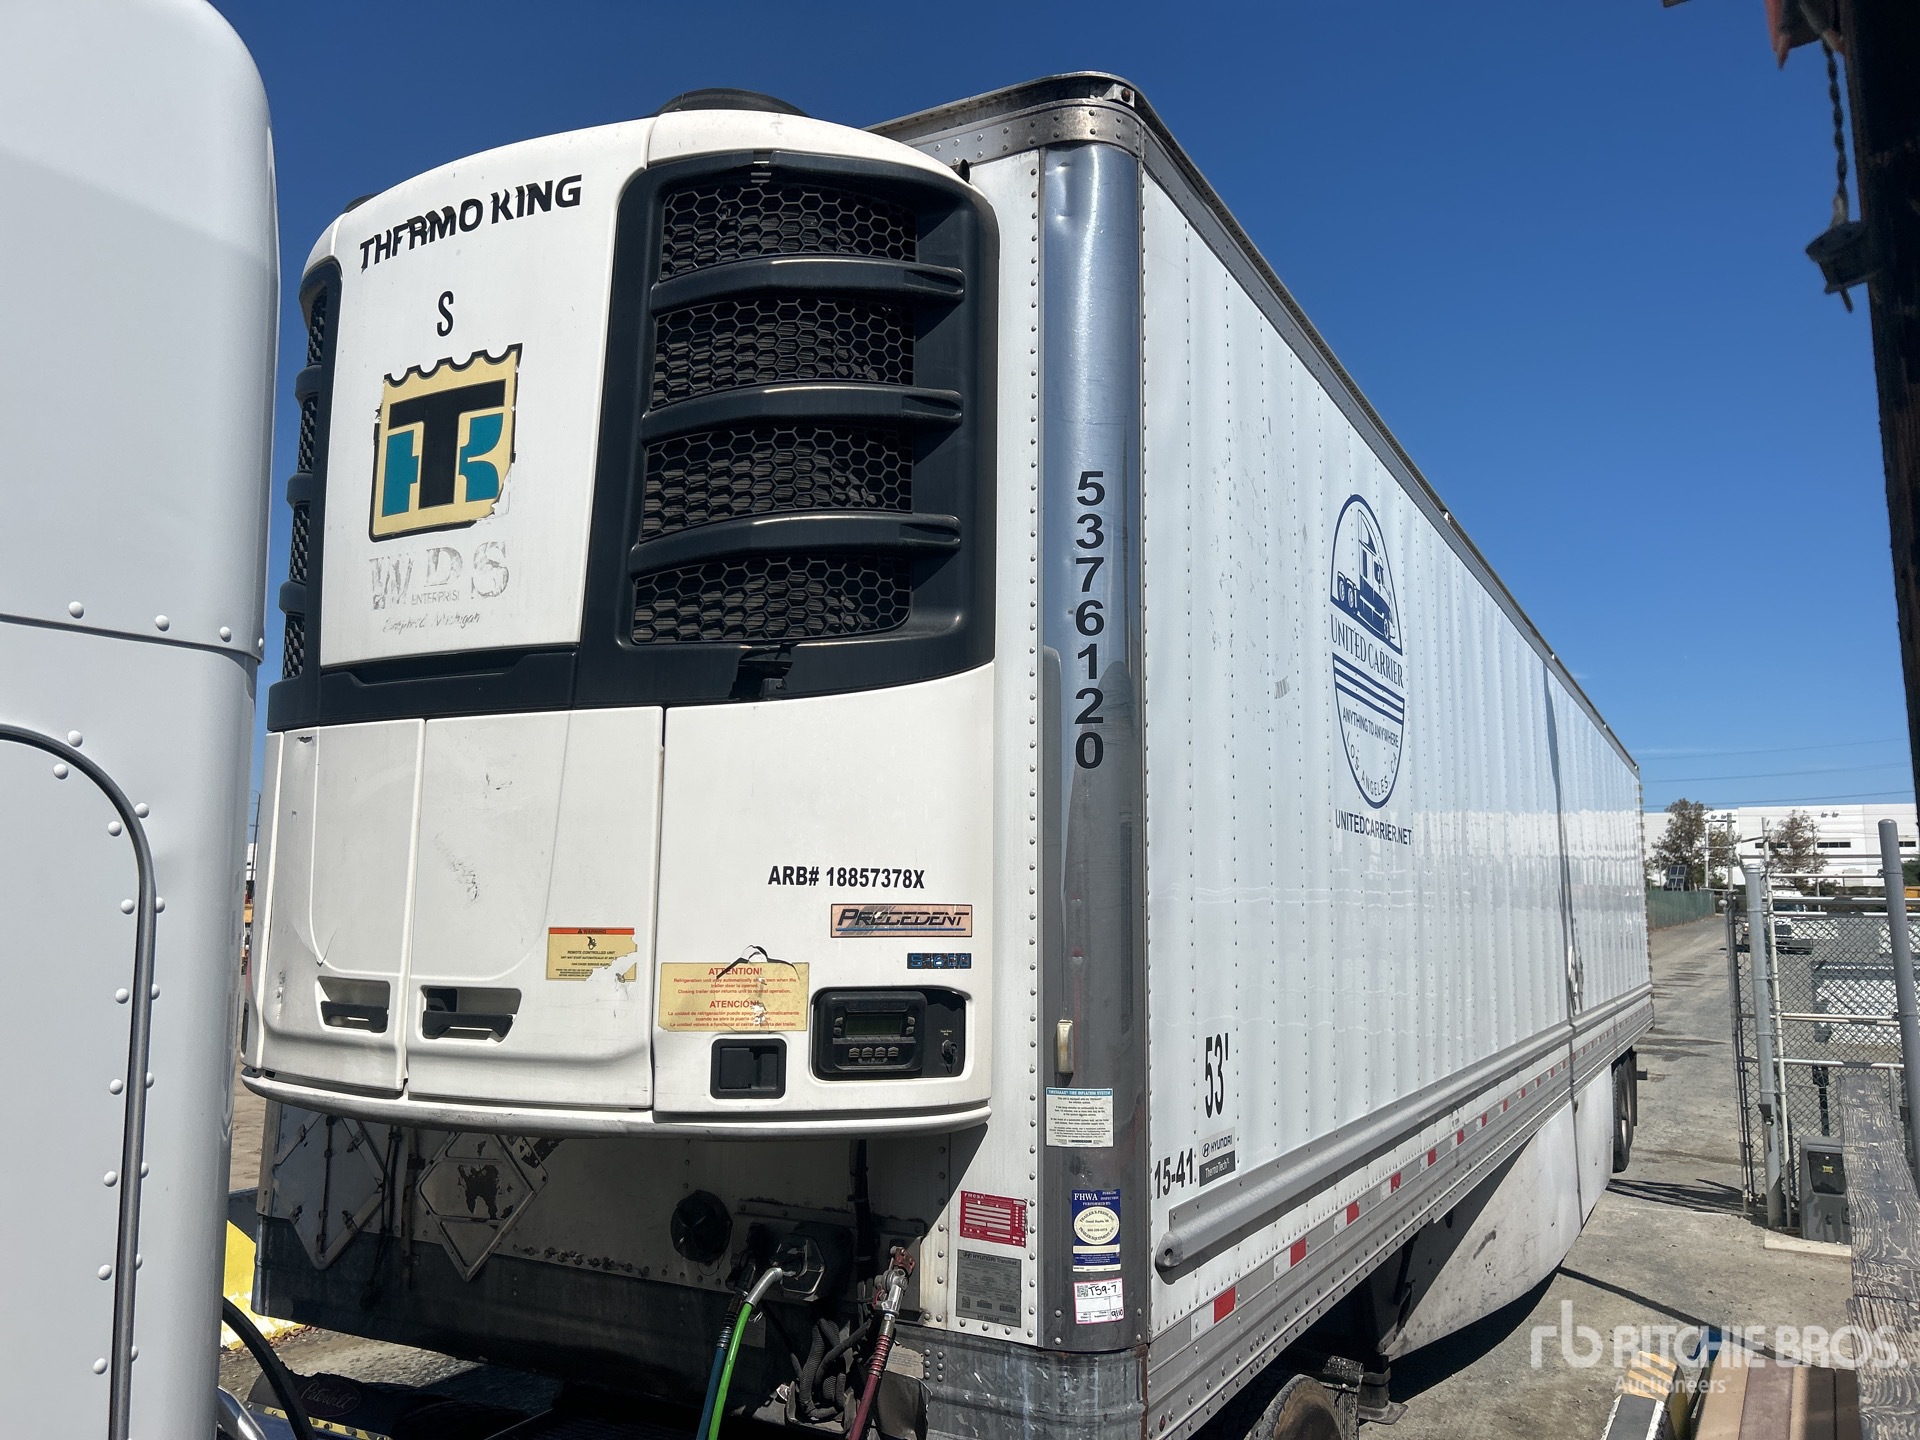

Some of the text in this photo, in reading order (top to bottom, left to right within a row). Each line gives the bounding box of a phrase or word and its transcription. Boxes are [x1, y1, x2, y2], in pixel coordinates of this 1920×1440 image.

[490, 174, 583, 224] KING
[436, 290, 454, 337] S
[1330, 613, 1405, 689] UNITED CARRIER
[1342, 706, 1368, 733] ANYTHING
[1374, 724, 1399, 748] ANYWHERE
[1346, 730, 1360, 771] LOS
[1335, 808, 1413, 846] UNITEDCARRIER.NET
[768, 866, 925, 889] ARB# 18857378X
[708, 967, 763, 976] ATTENTION!
[1210, 1134, 1233, 1153] HYUNDAI
[1154, 1147, 1193, 1200] 15-41
[1074, 1192, 1098, 1201] FHWA
